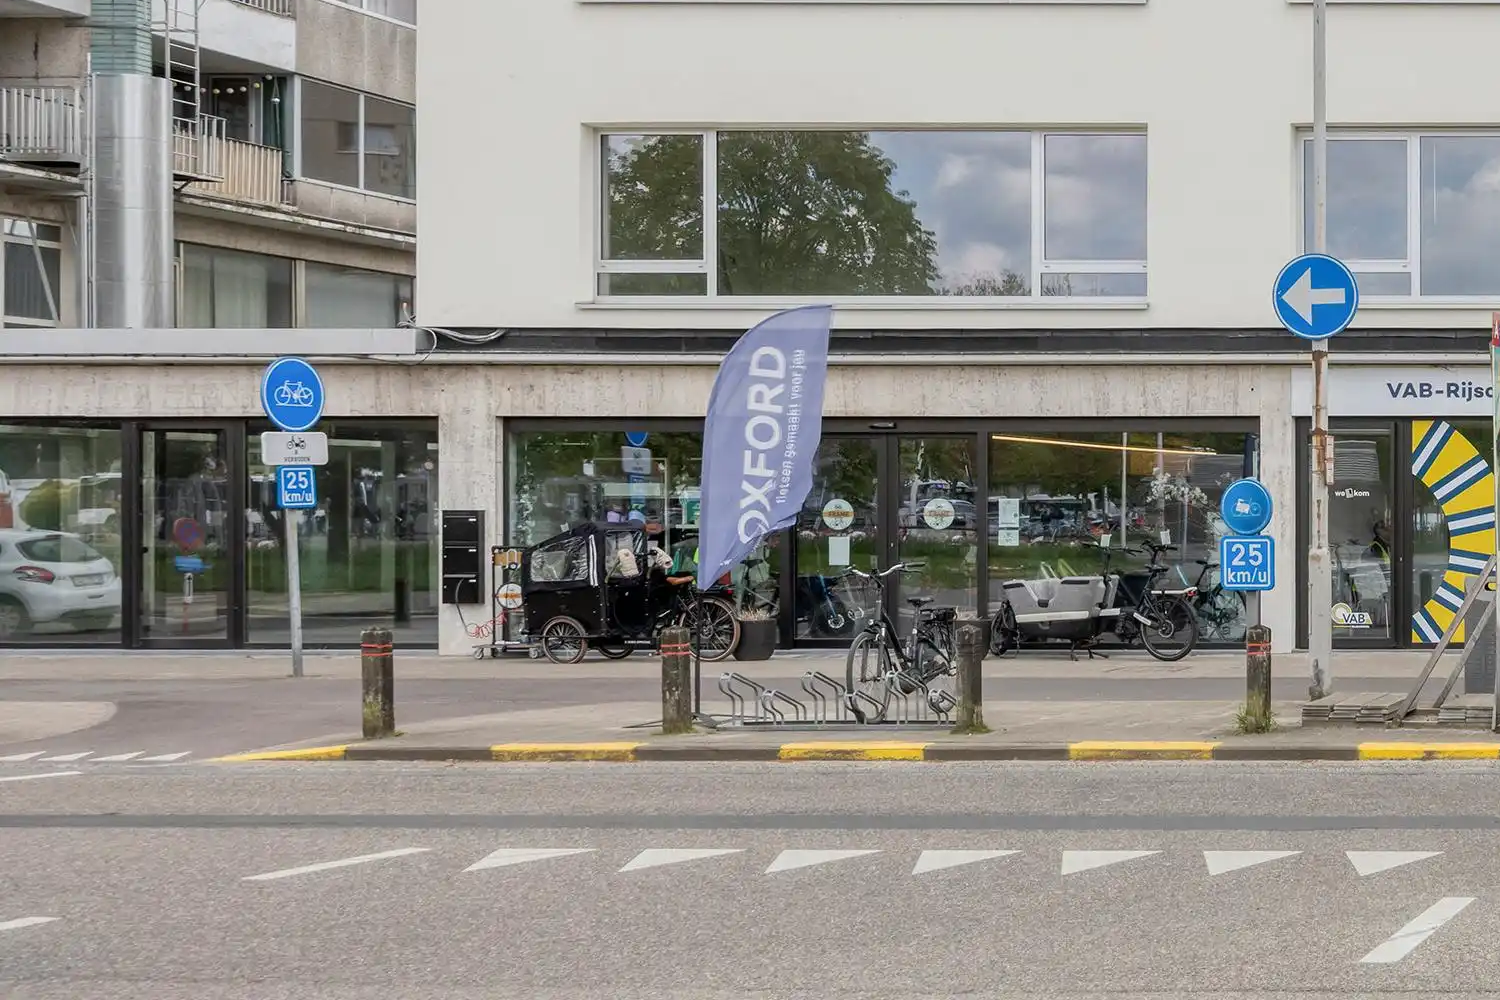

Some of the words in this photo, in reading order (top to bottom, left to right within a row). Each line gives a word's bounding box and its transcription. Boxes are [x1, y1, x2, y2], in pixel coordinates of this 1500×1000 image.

[794, 349, 806, 373] jou
[791, 374, 804, 402] voor
[784, 404, 800, 457] gemaakt
[737, 346, 787, 544] OXFORD
[286, 471, 309, 489] 25
[285, 491, 312, 502] km/u
[1231, 543, 1263, 566] 25
[1228, 568, 1267, 583] km/u
[1342, 613, 1366, 623] VAB
